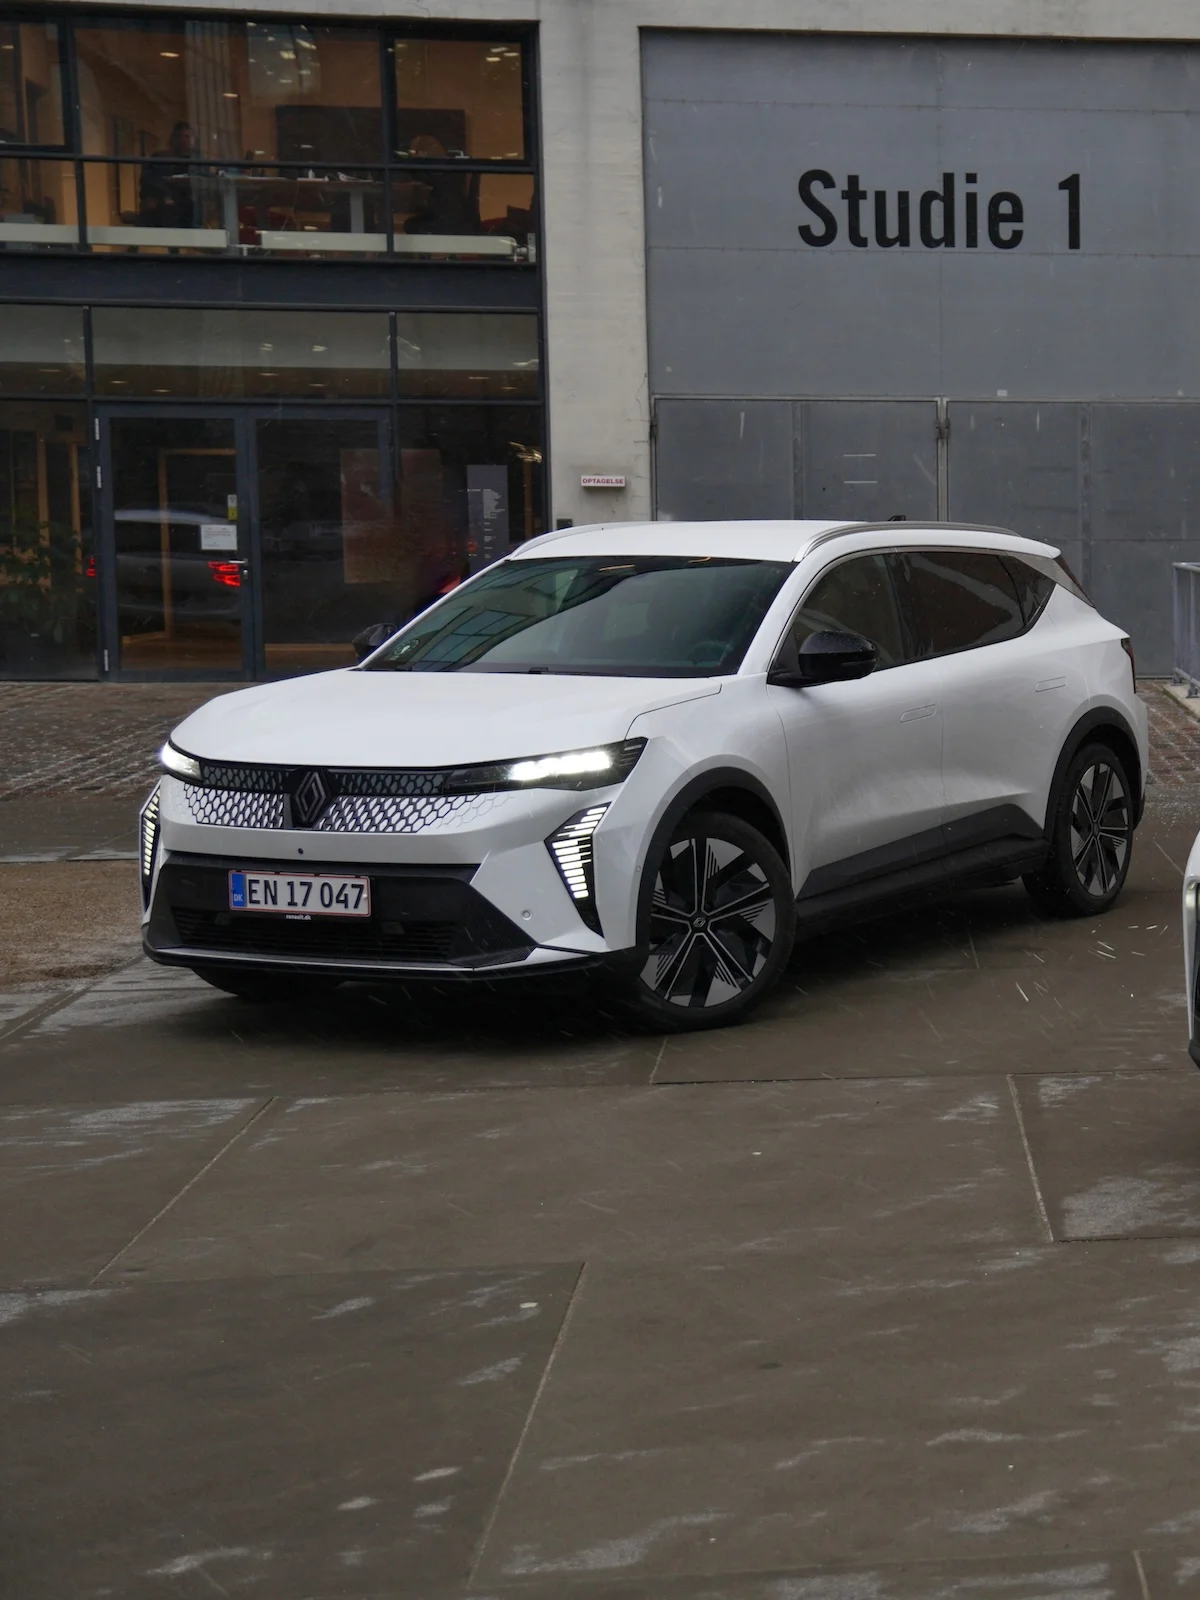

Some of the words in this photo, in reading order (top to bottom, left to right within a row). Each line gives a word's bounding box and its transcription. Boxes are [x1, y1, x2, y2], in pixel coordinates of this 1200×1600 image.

[797, 169, 1024, 249] Studie
[1058, 173, 1081, 250] 1
[233, 894, 243, 902] DK
[248, 879, 278, 905] EN
[287, 880, 313, 907] 17
[320, 882, 365, 909] 047
